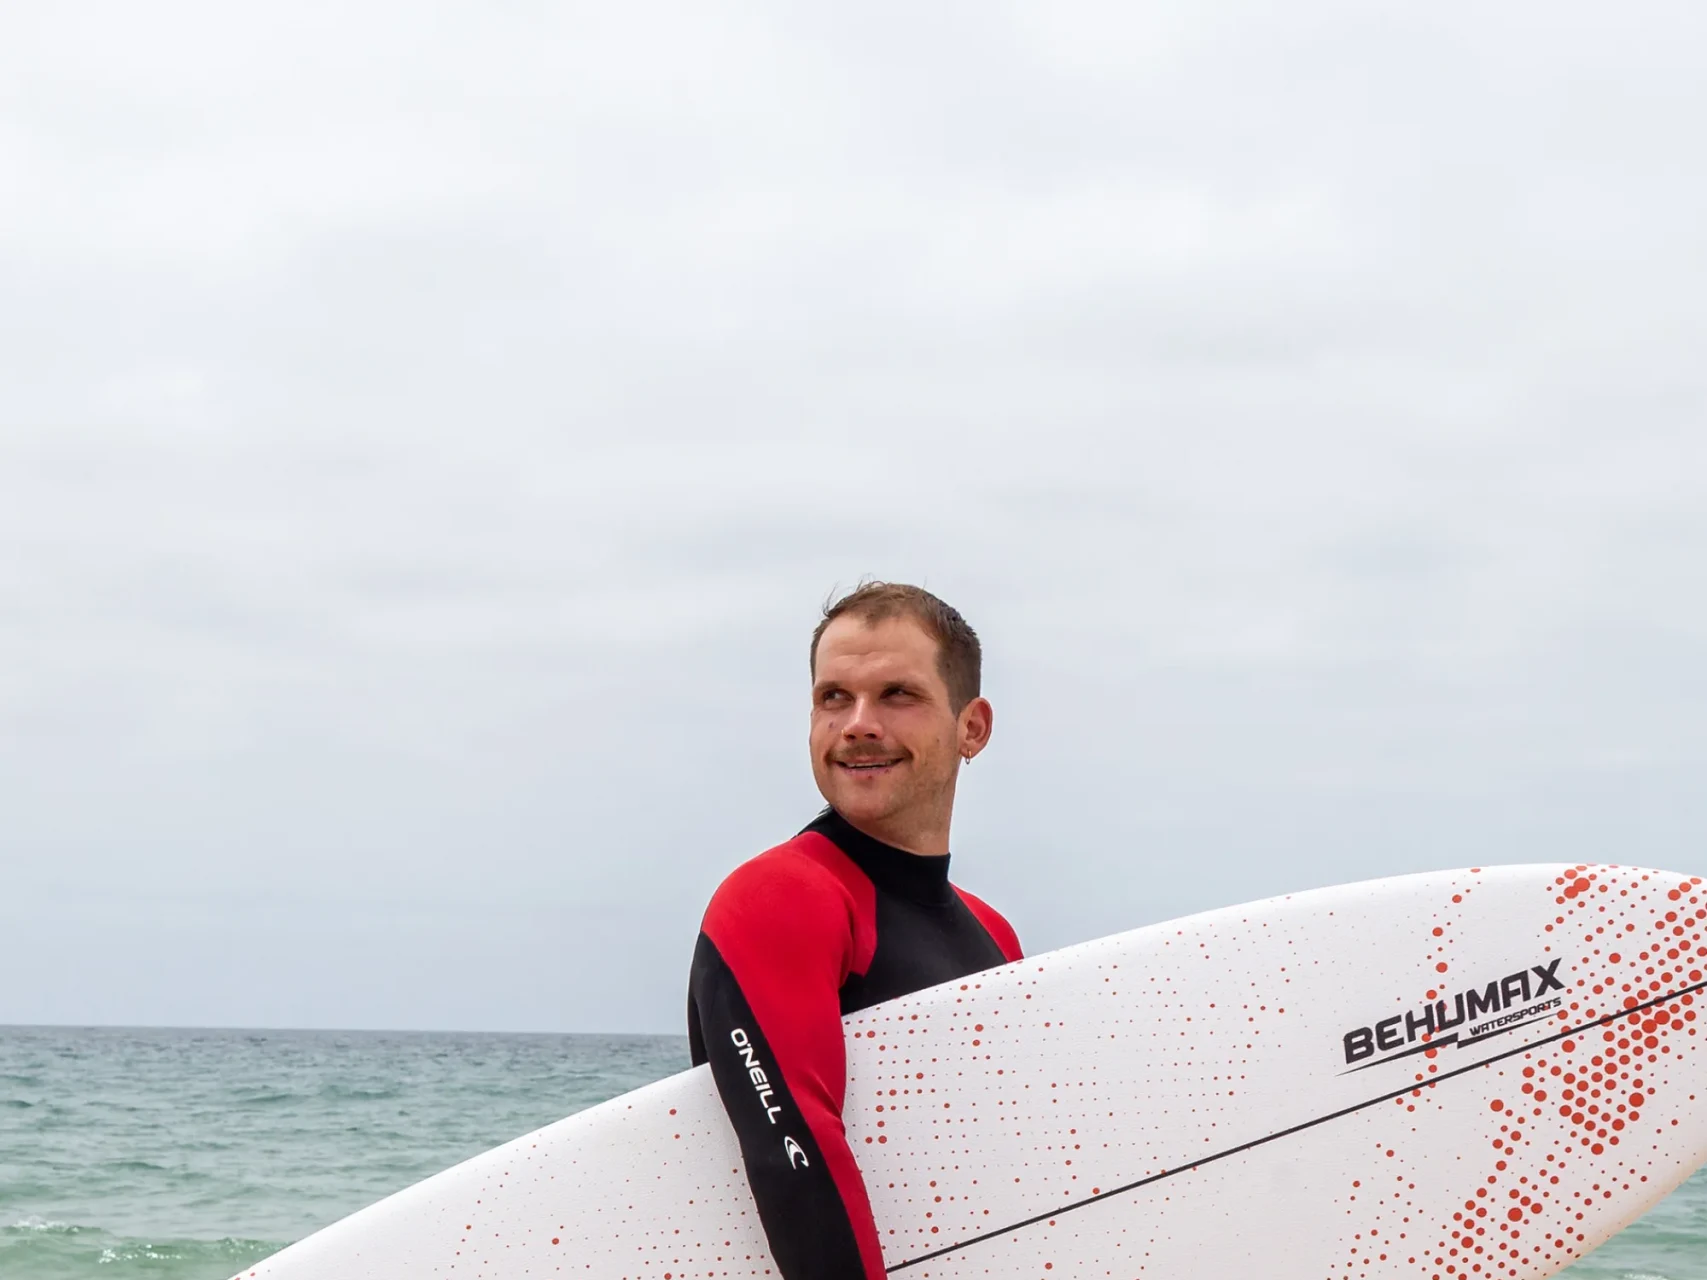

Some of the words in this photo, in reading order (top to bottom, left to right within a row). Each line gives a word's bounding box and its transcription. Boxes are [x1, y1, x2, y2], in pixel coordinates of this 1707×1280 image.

[1343, 957, 1566, 1064] BEHUMAX
[1469, 996, 1562, 1037] WATERSPORTS
[730, 1027, 782, 1124] O'NEILL
